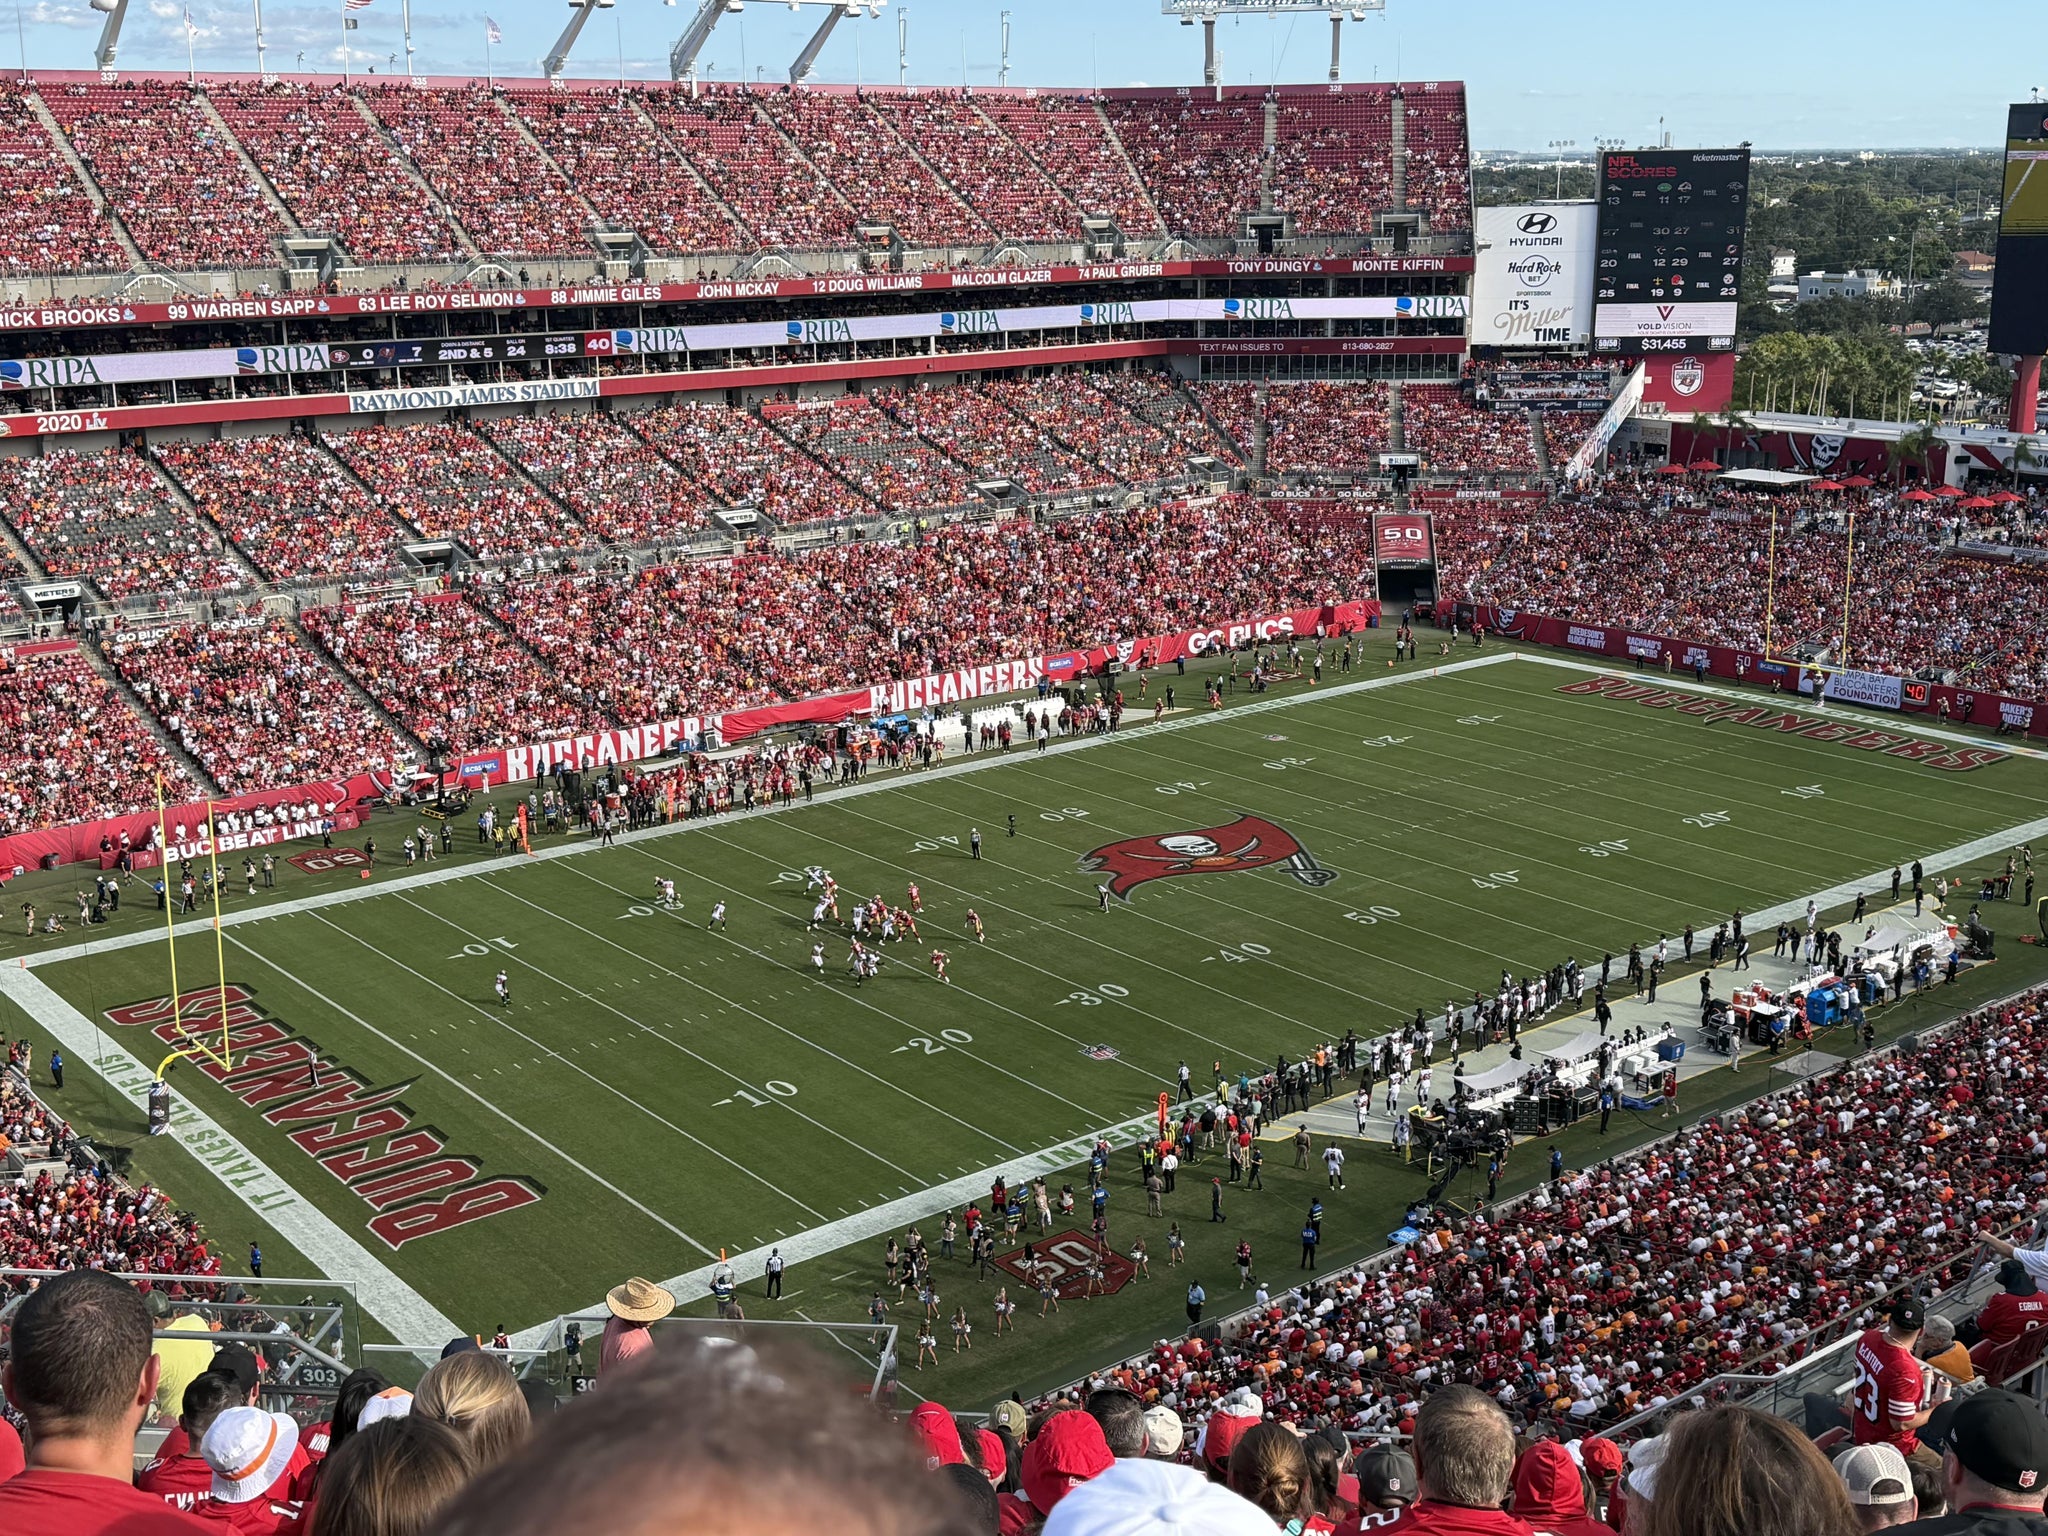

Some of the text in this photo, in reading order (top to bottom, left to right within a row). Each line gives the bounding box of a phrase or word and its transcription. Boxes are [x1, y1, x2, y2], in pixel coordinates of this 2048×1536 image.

[101, 72, 118, 82] 337
[411, 77, 427, 87] 335
[1608, 156, 1639, 167] NFL
[1693, 154, 1743, 162] ticketmaster
[1607, 166, 1677, 179] SCORES
[1674, 227, 1690, 235] 27
[1510, 238, 1562, 246] HYUNDAI
[1227, 260, 1310, 273] TONY DUNGY
[1352, 259, 1444, 271] MONTE KIFFIN
[1508, 261, 1562, 275] Hard Rock
[1600, 259, 1618, 267] 20
[1671, 258, 1689, 266] 29
[1723, 258, 1739, 266] 27
[952, 270, 1051, 287] MALCOLM GLAZER
[1078, 264, 1162, 279] 74 PAUL GRUBER
[697, 282, 779, 298] JOHN MCKAY
[813, 276, 922, 292] 12 DOUG WILLIAMS
[1720, 288, 1737, 296] 23
[551, 287, 661, 304] 88 JIMMIE GILES
[1599, 290, 1615, 298] 25
[1650, 289, 1664, 297] 19
[1673, 289, 1682, 297] 9
[168, 300, 314, 319] 99 WARREN SAPP
[359, 292, 513, 312] 63 LEE ROY SELMON
[1243, 298, 1293, 319] RIPA
[1416, 296, 1468, 318] RIPA
[1509, 300, 1530, 311] IT'S
[42, 308, 120, 325] BROOKS
[1094, 302, 1136, 324] RIPA
[957, 310, 1000, 333] RIPA
[1494, 306, 1574, 341] Miller
[635, 327, 688, 351] RIPA
[805, 319, 852, 343] RIPA
[1533, 328, 1571, 342] TIME
[411, 347, 422, 357] 7
[507, 346, 526, 356] 24
[545, 343, 576, 354] 8:38
[587, 339, 609, 350] 40
[1240, 343, 1269, 351] ISSUES
[1270, 343, 1284, 351] TO
[1641, 338, 1687, 350] $31,455
[259, 345, 330, 373] RIPA
[362, 349, 374, 359] 0
[439, 347, 493, 360] 2ND & 5
[26, 357, 103, 387] RIPA
[351, 380, 599, 412] RAYMOND JAMES STADIUM
[37, 415, 82, 432] 2020
[1384, 528, 1422, 540] 50
[1818, 523, 1832, 532] GO
[1887, 532, 1928, 543] GO BUCS
[35, 588, 75, 597] METERS
[211, 621, 230, 631] GO
[117, 632, 136, 643] GO
[1188, 617, 1294, 654] GO BUCS
[1567, 634, 1606, 649] BLOCK PARTY
[1737, 654, 1751, 667] 50
[870, 657, 1043, 713] BUCCANEERS
[1834, 677, 1898, 695] BUCCANEERS
[1868, 675, 1887, 684] BAY
[1833, 687, 1898, 706] FOUNDATION
[1906, 684, 1926, 700] 40
[1218, 698, 1294, 718] CANCER
[2000, 702, 2033, 718] BAKER'S
[1456, 716, 1496, 726] 10
[1552, 676, 2010, 771] BUCCANEERS
[1362, 735, 1405, 748] 20
[1262, 757, 1307, 771] 30
[1155, 780, 1200, 796] 40
[1780, 786, 1824, 800] 10
[1039, 806, 1091, 823] 50
[1682, 811, 1730, 829] 20
[166, 828, 277, 862] BUC BEAT
[914, 834, 960, 852] 40
[1578, 838, 1628, 857] 30
[304, 853, 366, 870] 50
[1472, 871, 1519, 890] 40
[1343, 904, 1402, 926] 50
[463, 935, 519, 957] 10
[1220, 941, 1272, 964] 40
[1068, 983, 1129, 1006] 30
[909, 1028, 973, 1055] 20
[734, 1079, 799, 1108] 10
[103, 985, 541, 1251] BUCCANEERS
[93, 1054, 297, 1212] IT TAKES OF US
[1010, 1240, 1102, 1281] 50
[2018, 1301, 2043, 1311] EGBUKA
[303, 1369, 337, 1383] 303
[1855, 1360, 1879, 1422] 23
